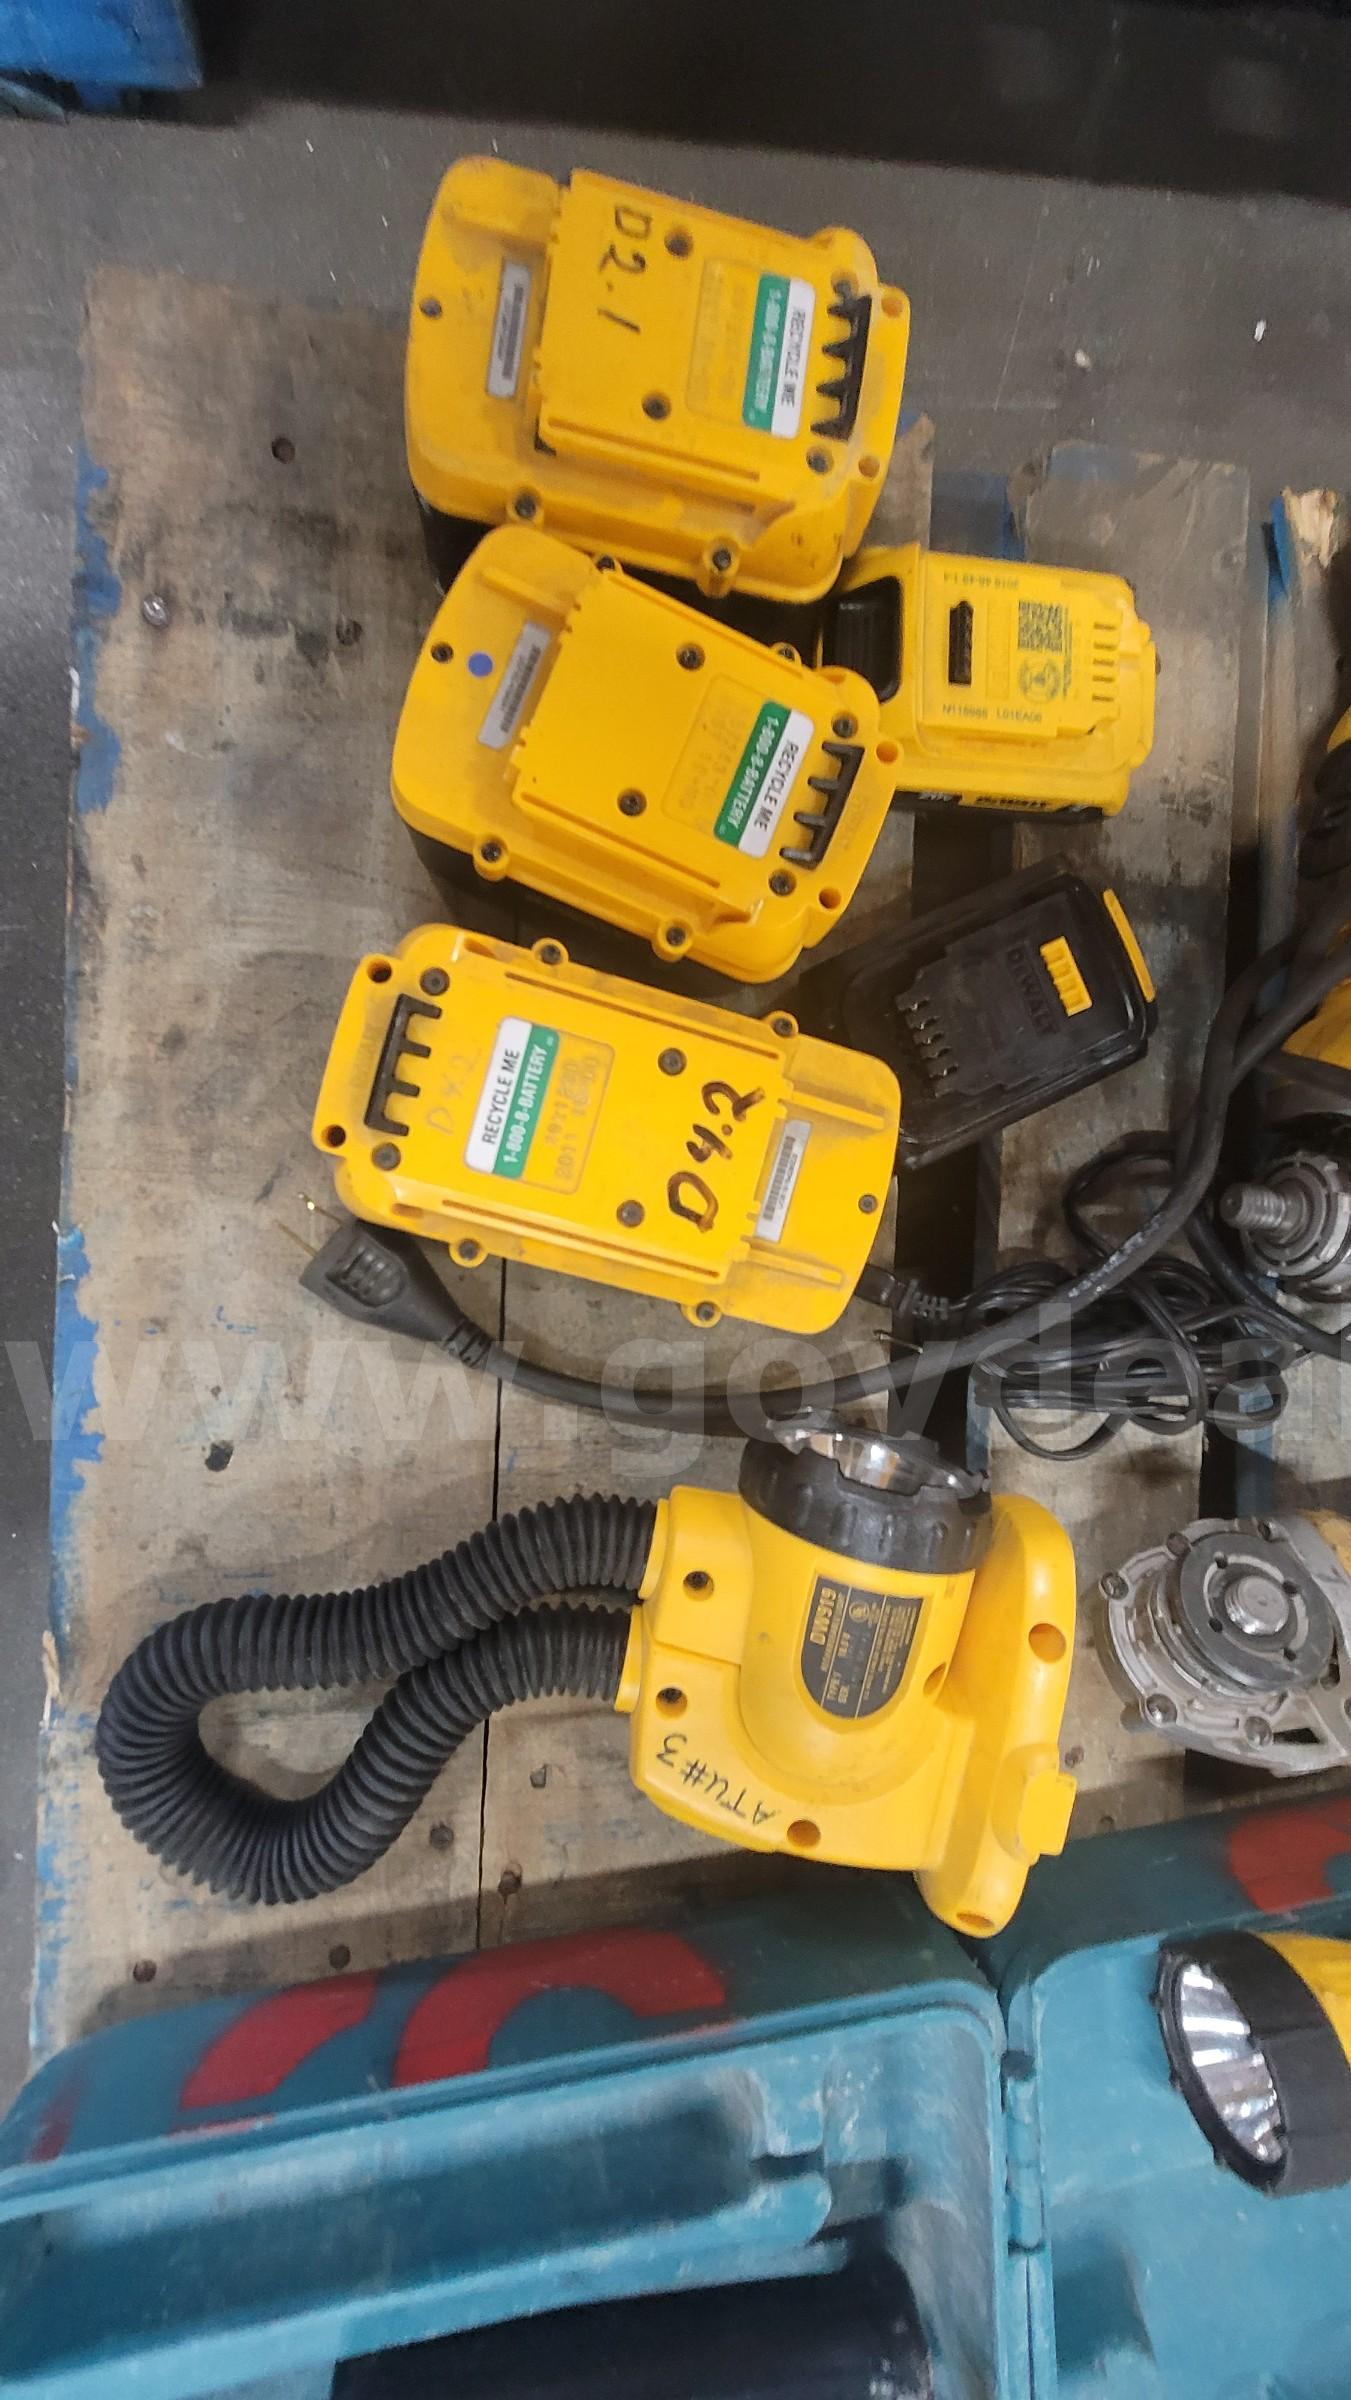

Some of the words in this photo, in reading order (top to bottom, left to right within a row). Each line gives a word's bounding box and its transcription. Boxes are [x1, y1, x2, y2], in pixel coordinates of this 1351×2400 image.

[597, 206, 652, 335] D2.1
[754, 805, 773, 831] ME
[764, 741, 799, 806] RECYCLE
[481, 1076, 512, 1145] RECYCLE
[502, 1048, 520, 1074] ME
[503, 1044, 548, 1163] 1-800-8-BATTERY
